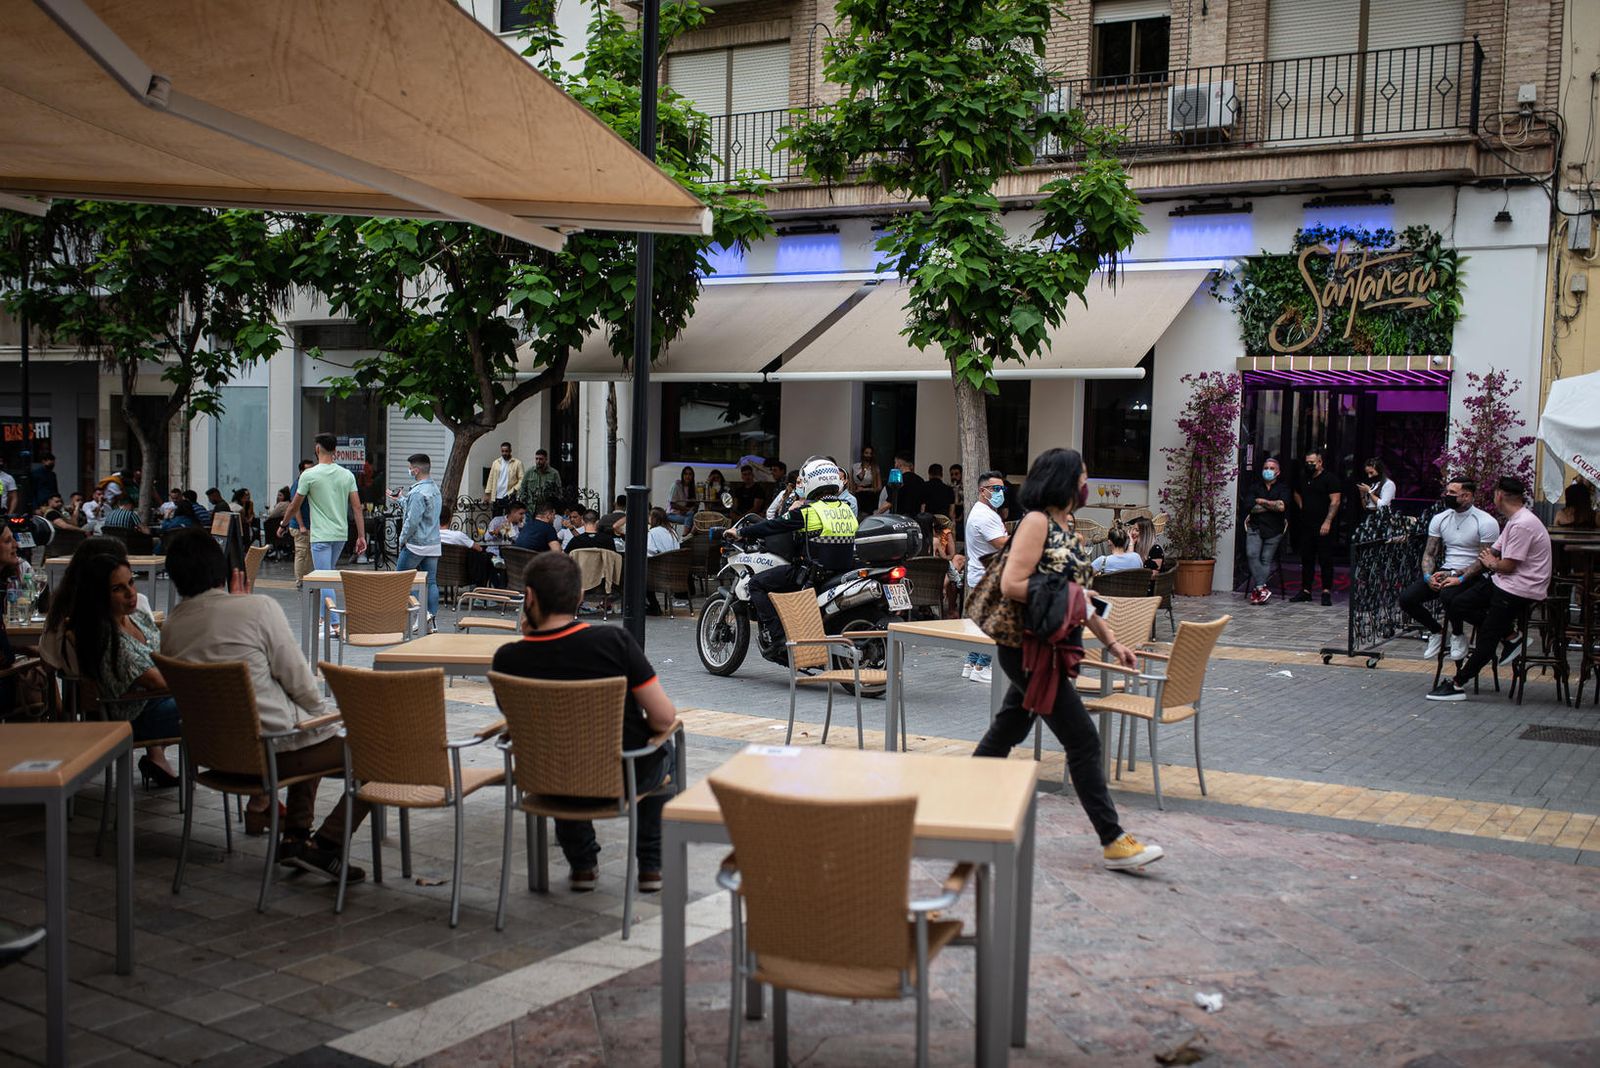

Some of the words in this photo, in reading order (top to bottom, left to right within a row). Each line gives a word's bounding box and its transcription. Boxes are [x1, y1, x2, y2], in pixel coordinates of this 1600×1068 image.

[4, 421, 50, 441] BAS-FIT
[332, 450, 364, 461] SPONIBLE
[831, 521, 854, 534] LOCAL
